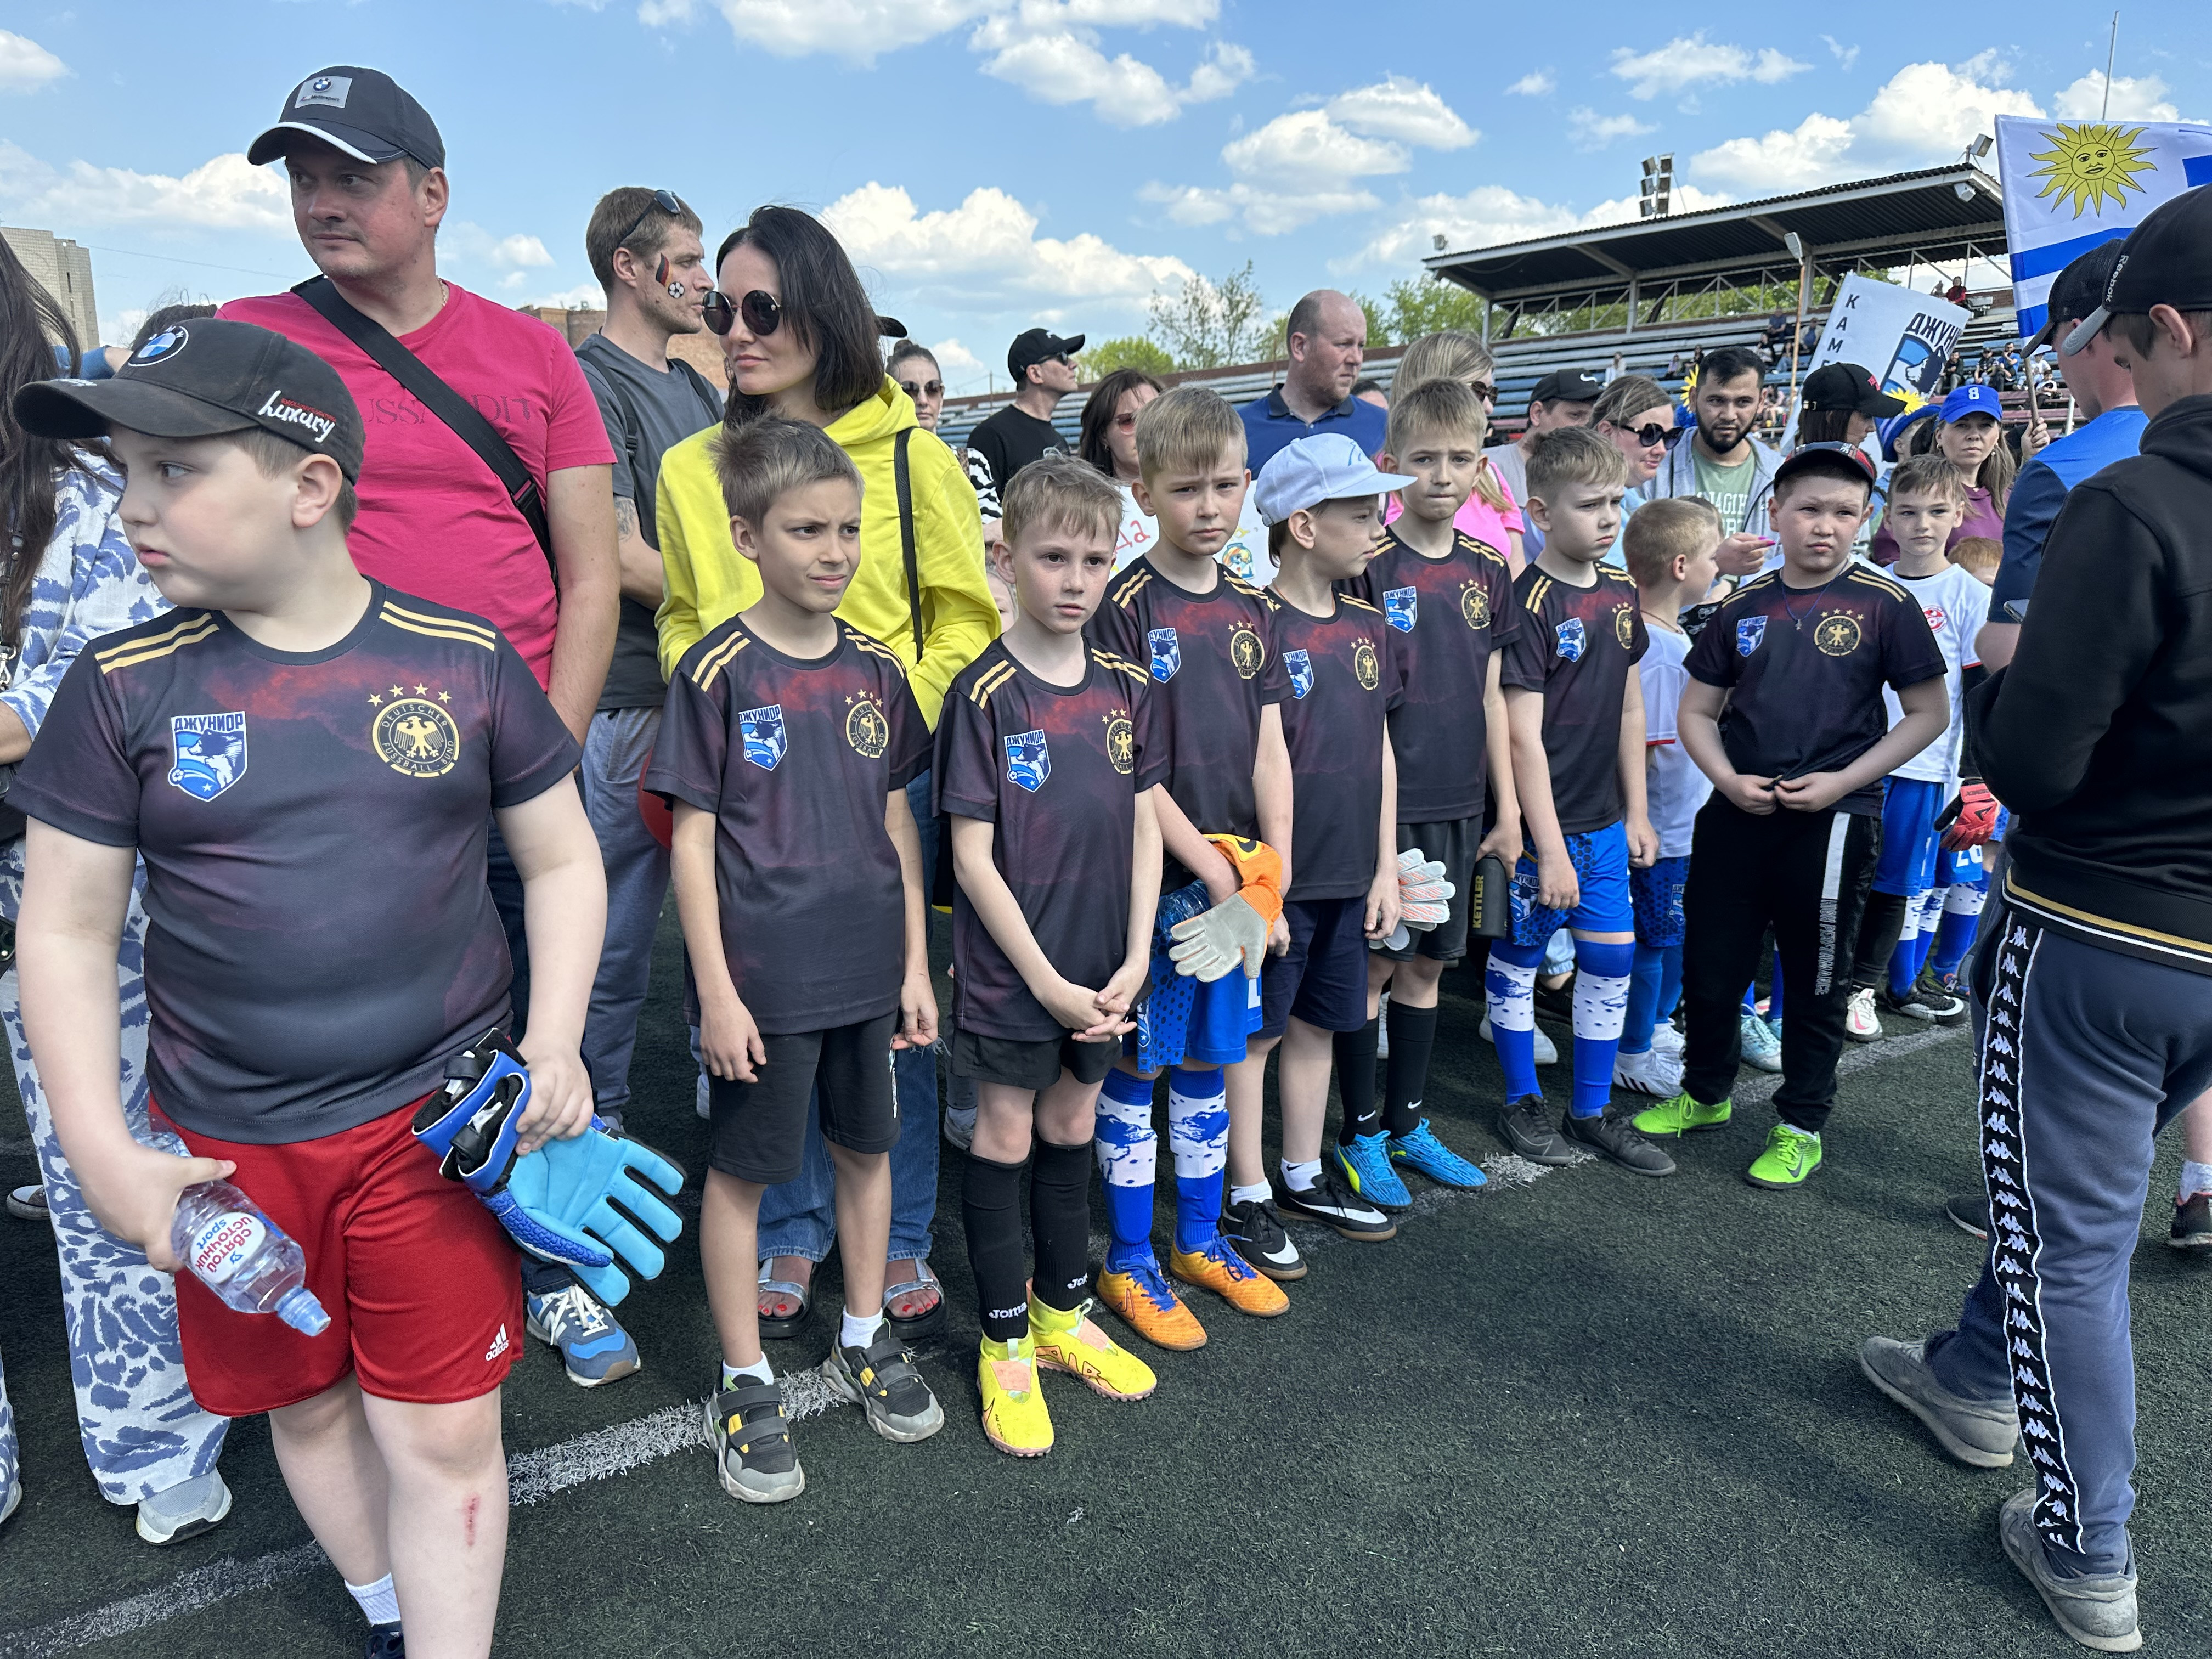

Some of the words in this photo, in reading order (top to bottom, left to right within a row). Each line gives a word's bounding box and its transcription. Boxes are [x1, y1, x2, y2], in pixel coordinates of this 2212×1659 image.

[2106, 255, 2129, 302] Reebok
[174, 713, 244, 732] ДЖУНИОР
[381, 704, 448, 729] DEUTSCHER
[1006, 731, 1044, 746] ДЖУНИОР
[1472, 874, 1484, 928] KETTLER
[196, 1218, 227, 1250] sport
[989, 1302, 1028, 1319] Joma
[486, 1339, 509, 1361] adidas
